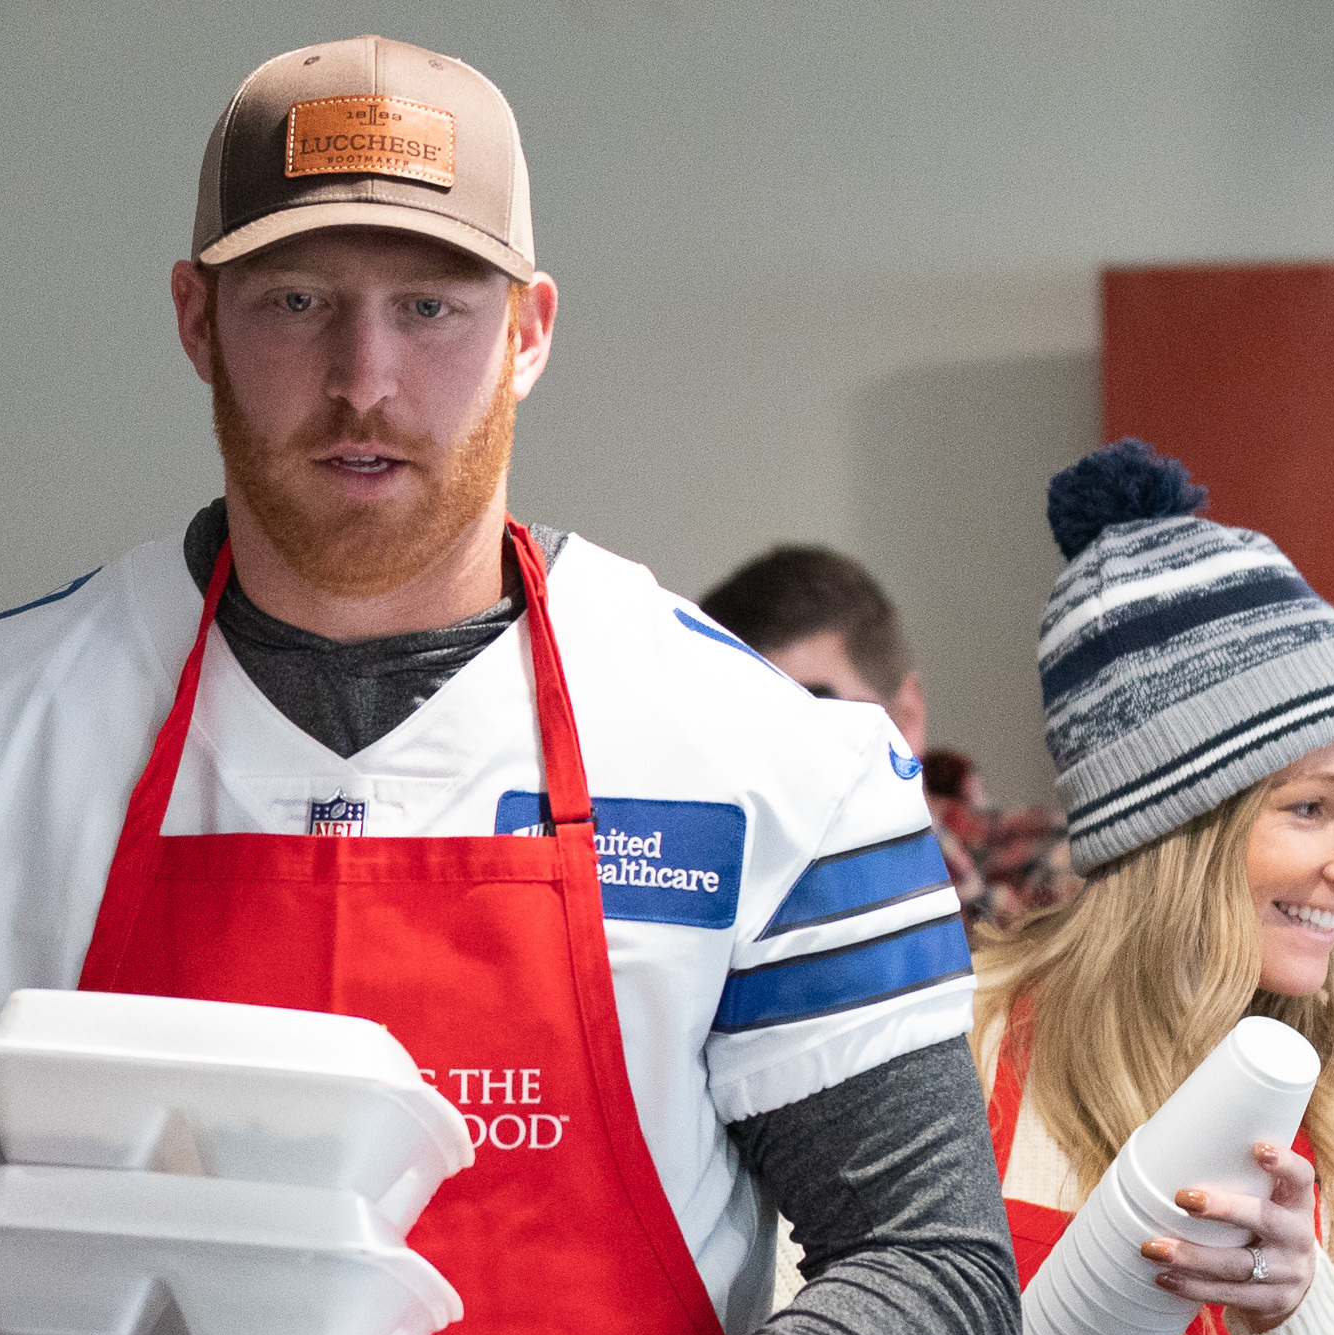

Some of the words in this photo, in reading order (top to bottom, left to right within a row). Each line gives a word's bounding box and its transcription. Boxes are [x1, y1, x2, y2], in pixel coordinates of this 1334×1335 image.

[299, 134, 438, 161] LUCCHESE
[592, 827, 663, 859] nited
[449, 1068, 542, 1105] THE
[462, 1113, 564, 1150] OOD
